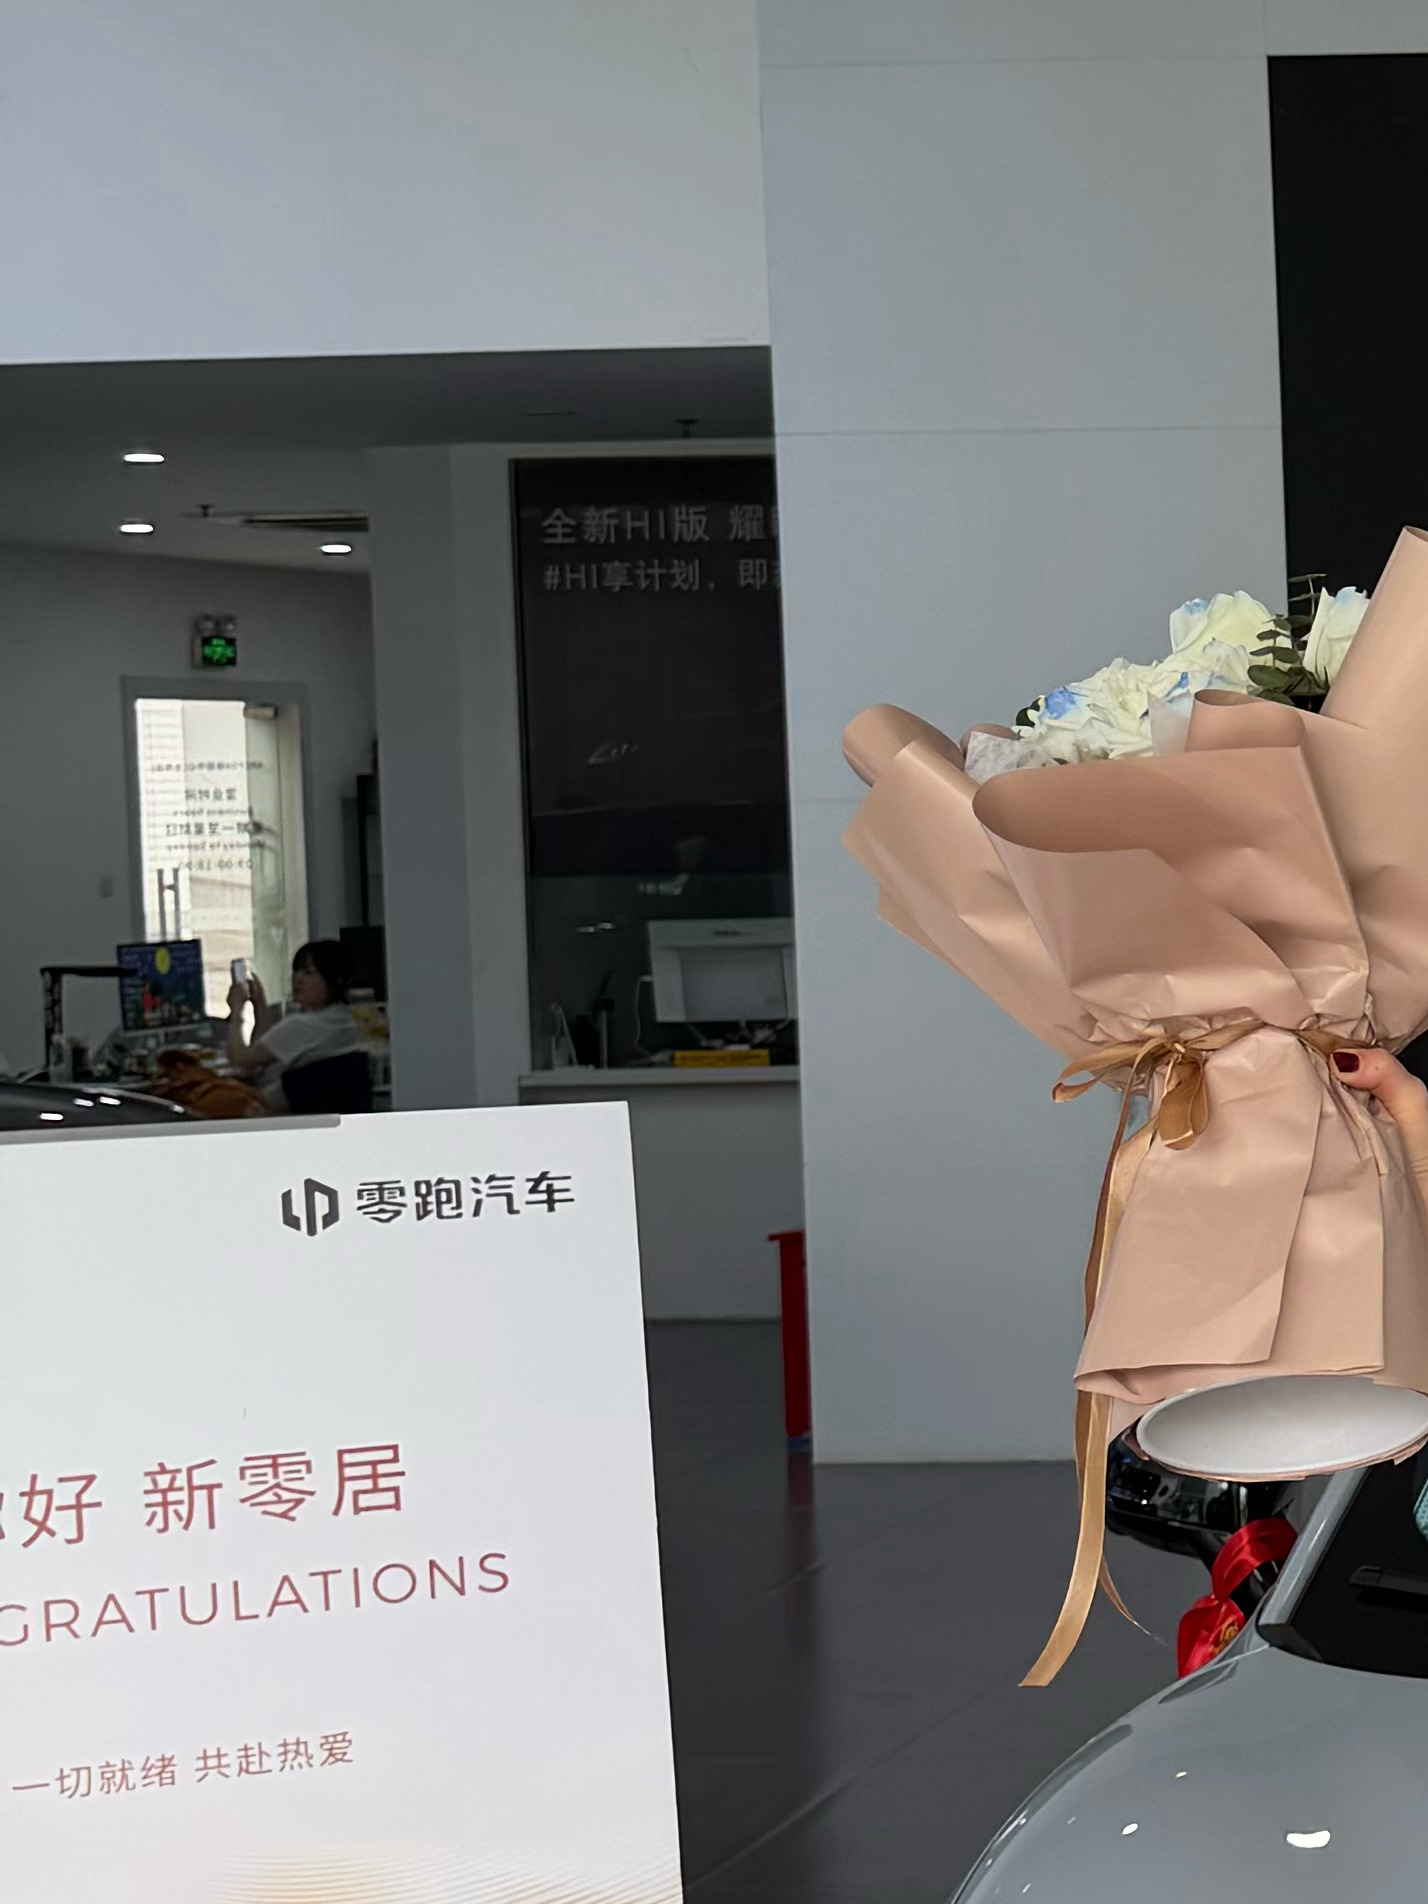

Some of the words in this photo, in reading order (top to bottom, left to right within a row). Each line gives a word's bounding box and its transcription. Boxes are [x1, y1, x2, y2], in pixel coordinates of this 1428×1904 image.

[541, 505, 711, 544] 全新HI版
[356, 1170, 576, 1224] 零跑汽车
[0, 1471, 103, 1549] 好
[142, 1443, 406, 1535] 新零居
[11, 1753, 178, 1800] 一切就绪
[194, 1730, 355, 1784] 共赴热爱
